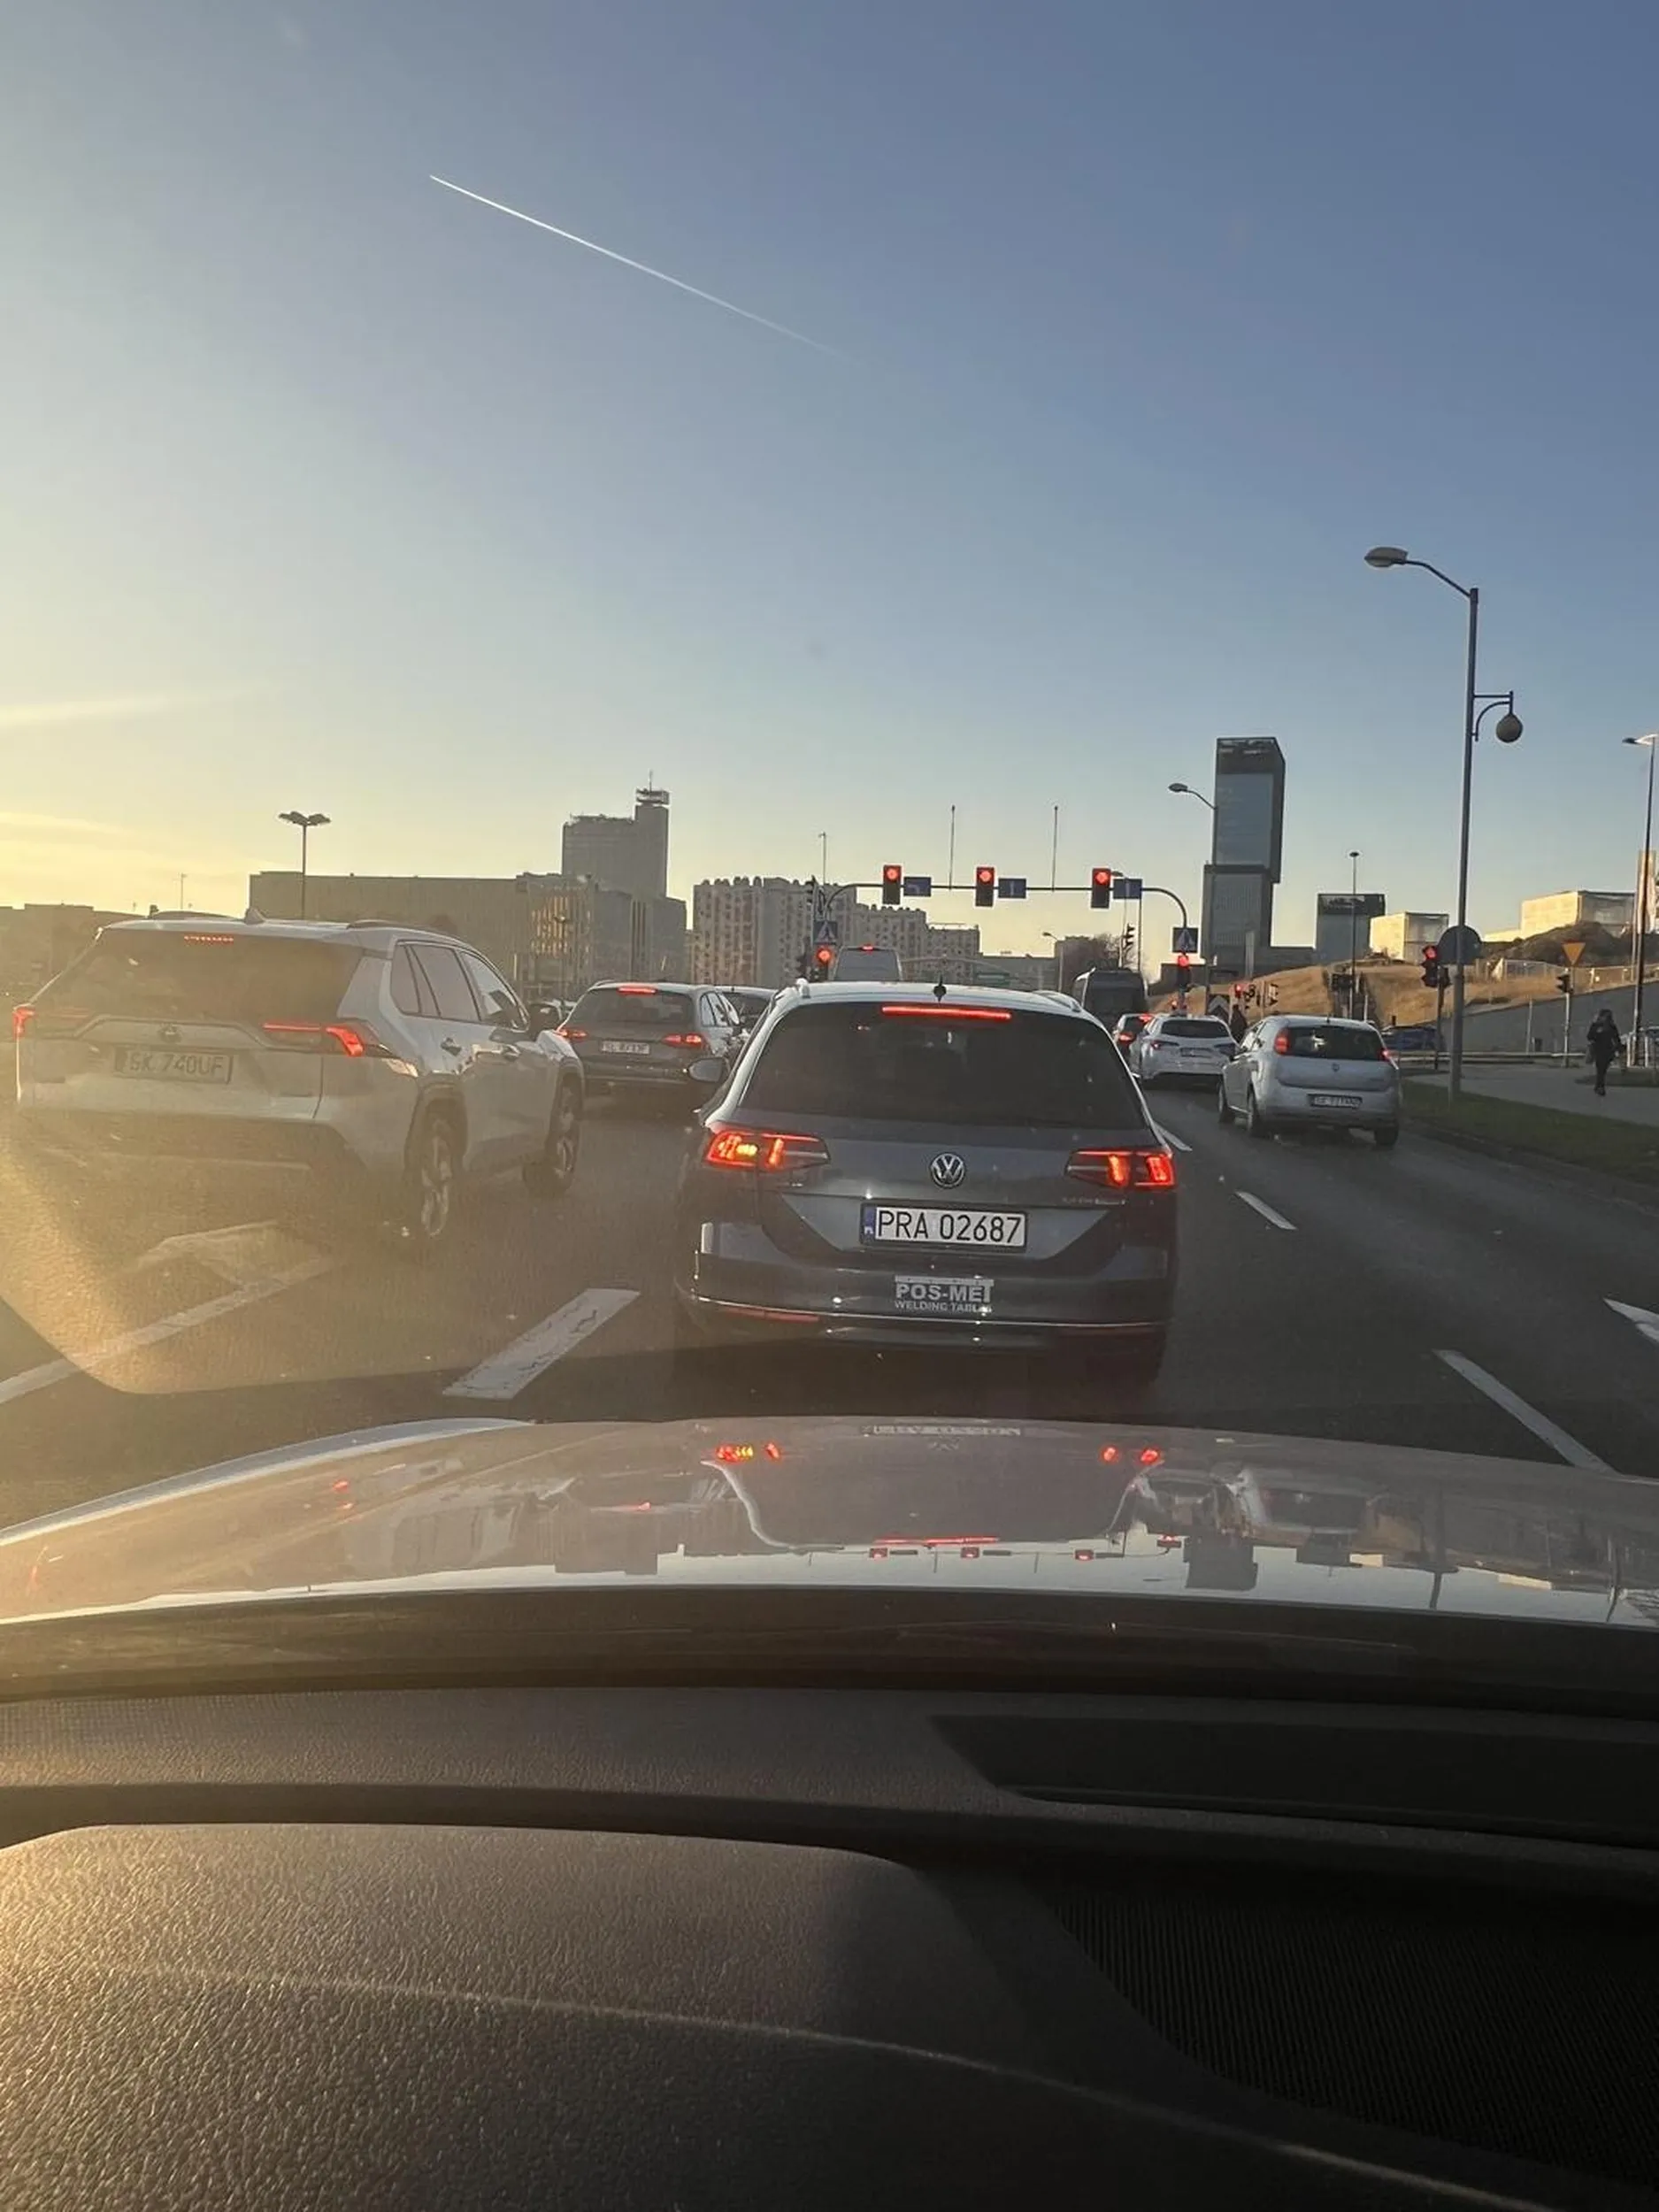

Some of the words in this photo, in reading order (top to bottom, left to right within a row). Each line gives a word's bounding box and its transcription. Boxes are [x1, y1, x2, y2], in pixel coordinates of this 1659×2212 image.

[878, 1210, 929, 1239] PRA
[940, 1214, 1022, 1243] 02687
[895, 1280, 995, 1303] POS-MET
[895, 1301, 948, 1312] WELDING
[950, 1302, 992, 1313] TABL
